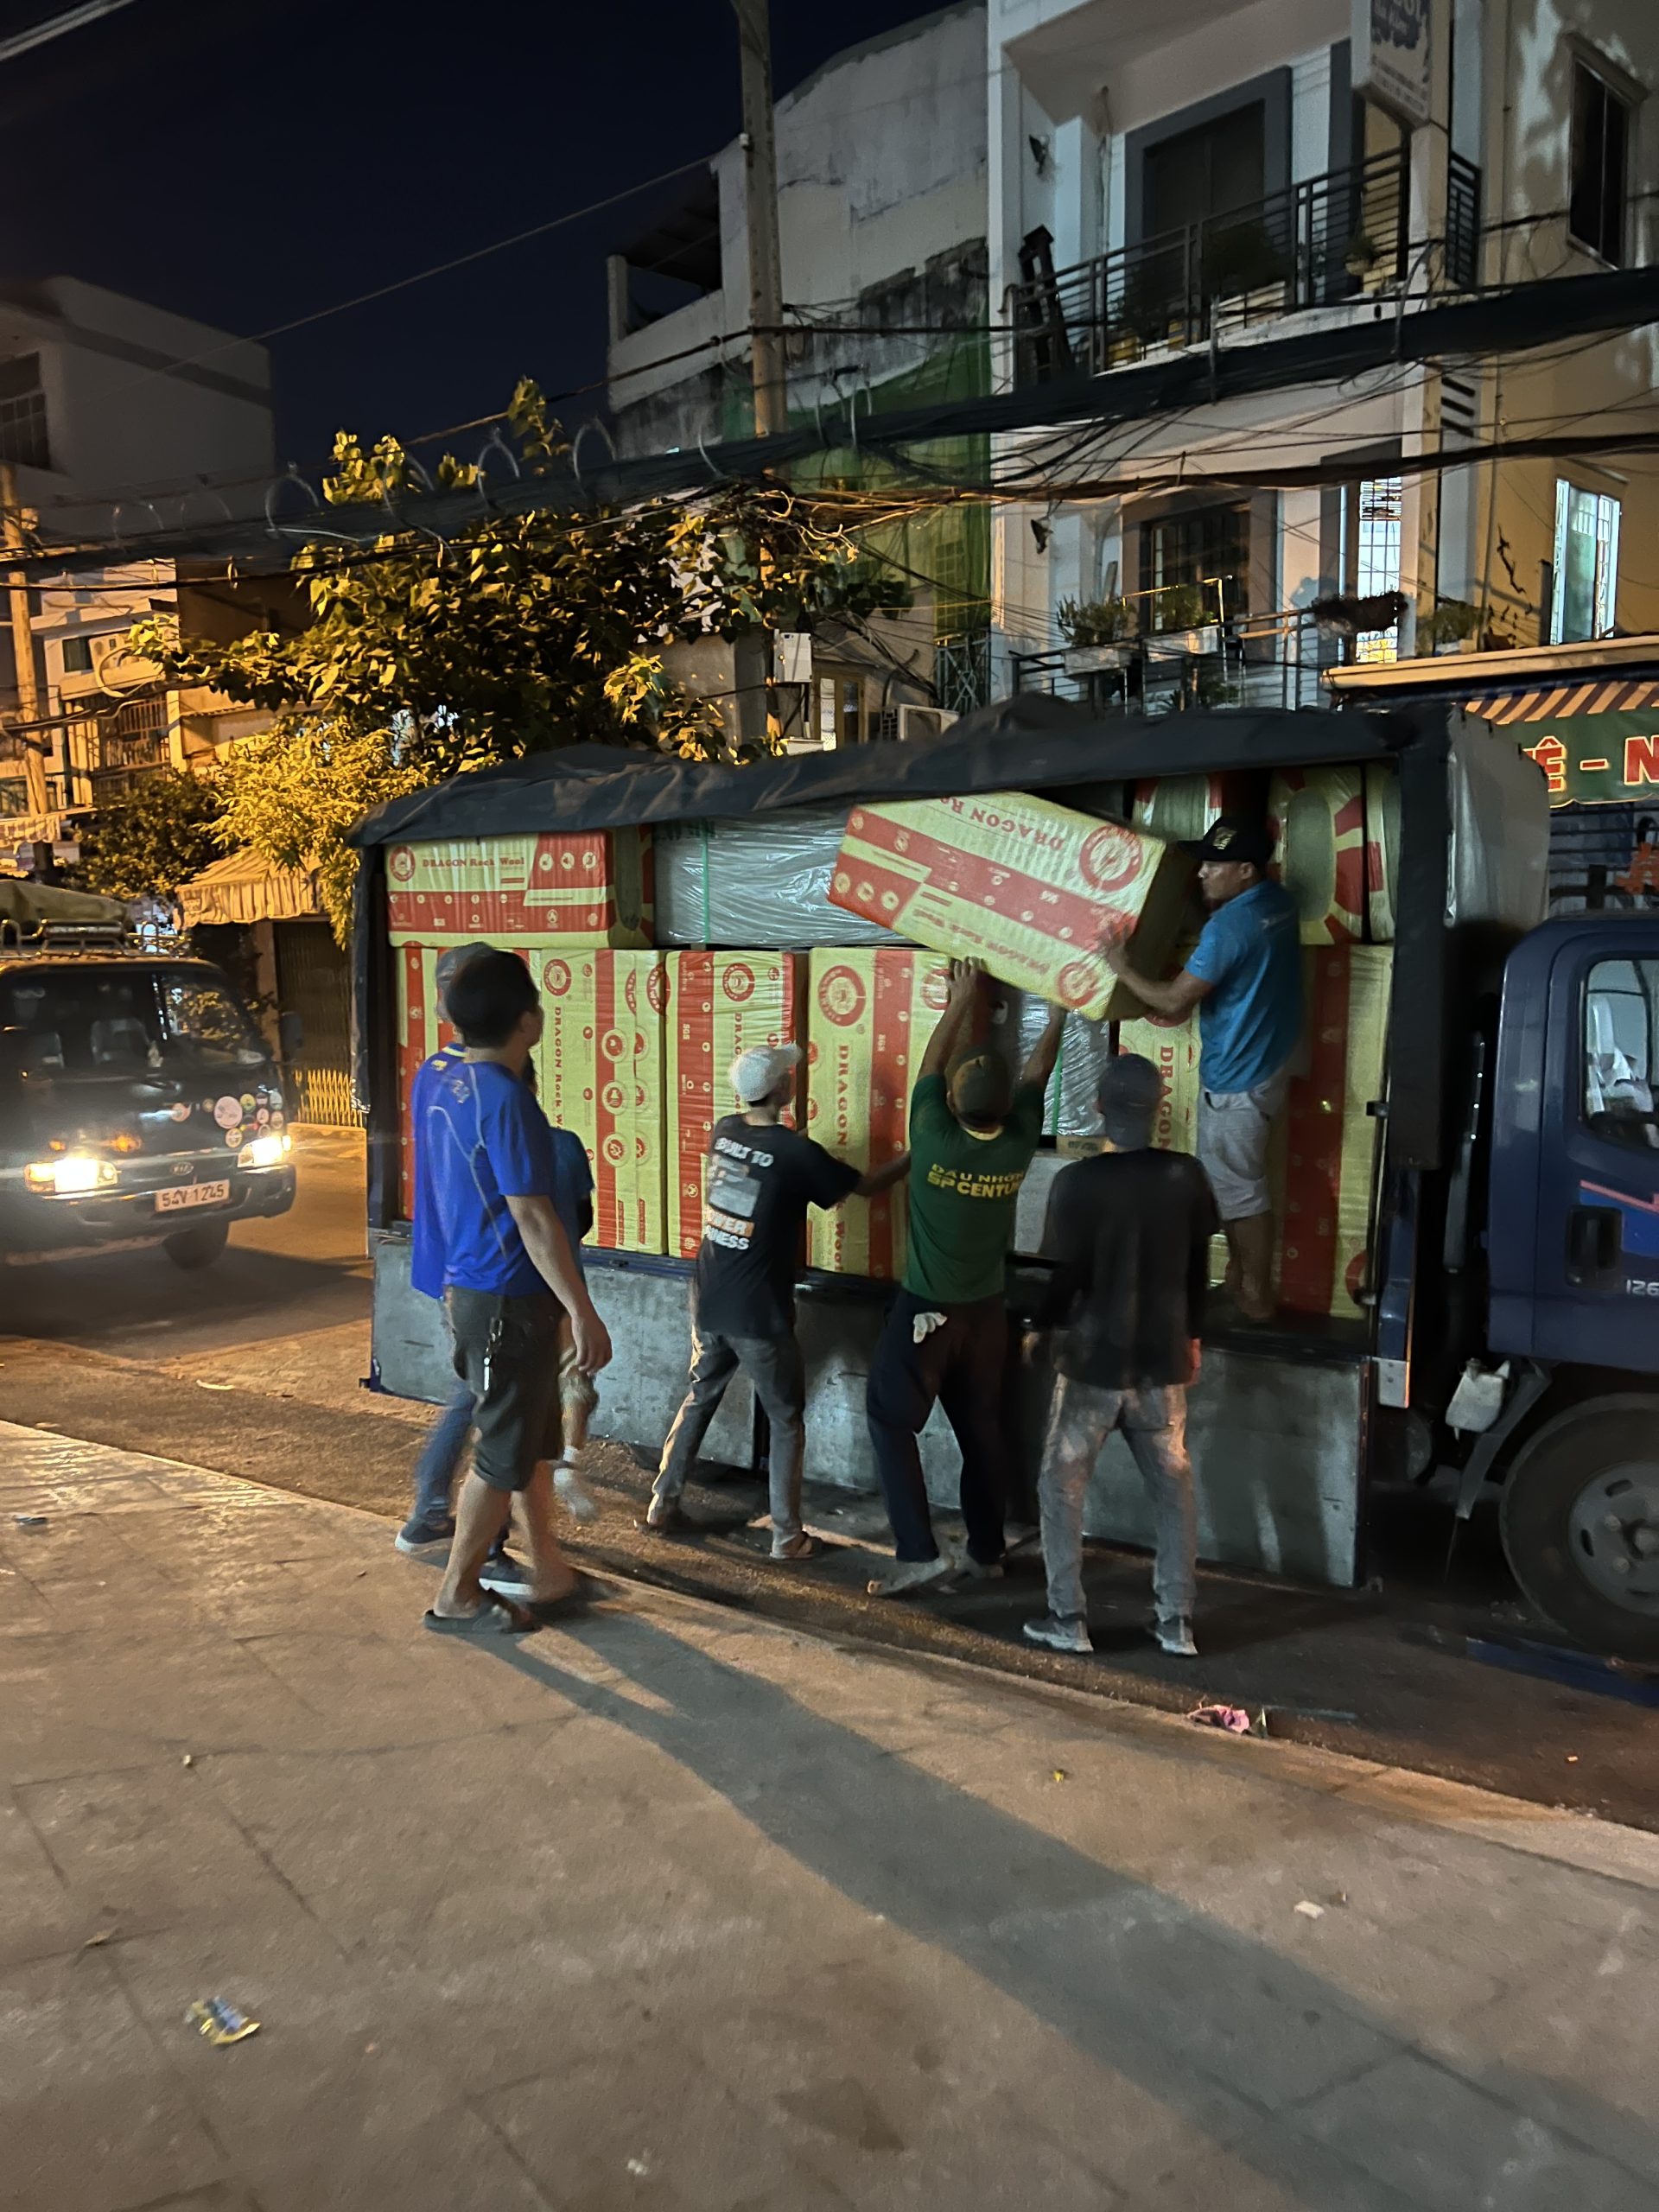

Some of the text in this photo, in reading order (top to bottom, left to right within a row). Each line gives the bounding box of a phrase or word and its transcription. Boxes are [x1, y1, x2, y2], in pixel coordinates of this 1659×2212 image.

[1523, 736, 1567, 792] Ê
[939, 797, 1065, 852] DRAGON Ro
[422, 856, 525, 868] DRAGON Rock Wool
[554, 1006, 563, 1068] DRAGON
[836, 1045, 849, 1146] DRAGON
[751, 1150, 774, 1167] TO
